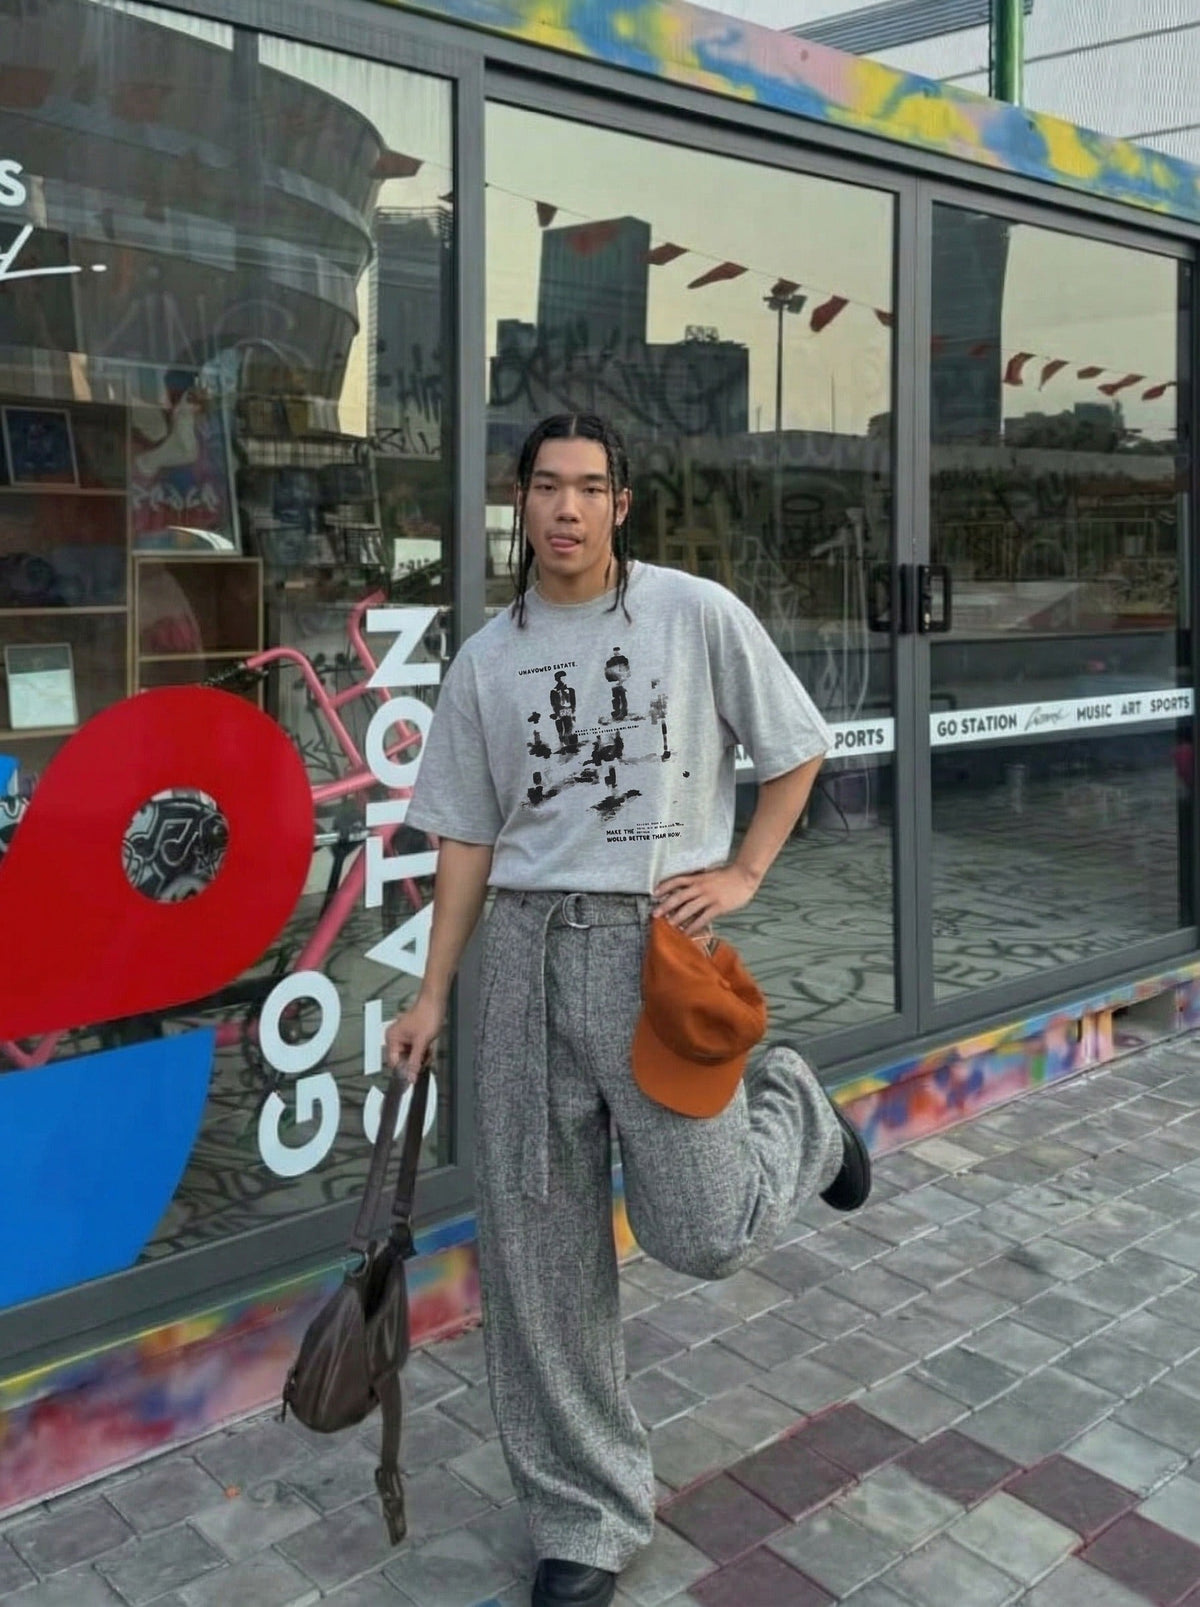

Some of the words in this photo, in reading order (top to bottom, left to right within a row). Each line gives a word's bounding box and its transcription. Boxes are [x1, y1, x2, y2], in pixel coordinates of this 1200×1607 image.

[518, 666, 552, 676] UNAVOWED
[936, 721, 958, 737] GO
[961, 714, 1018, 734] STATION
[1077, 704, 1112, 722] MUSIC
[1121, 700, 1142, 716] ART
[1150, 696, 1190, 712] SPORTS
[833, 728, 884, 749] PORTS
[258, 970, 341, 1177] GO
